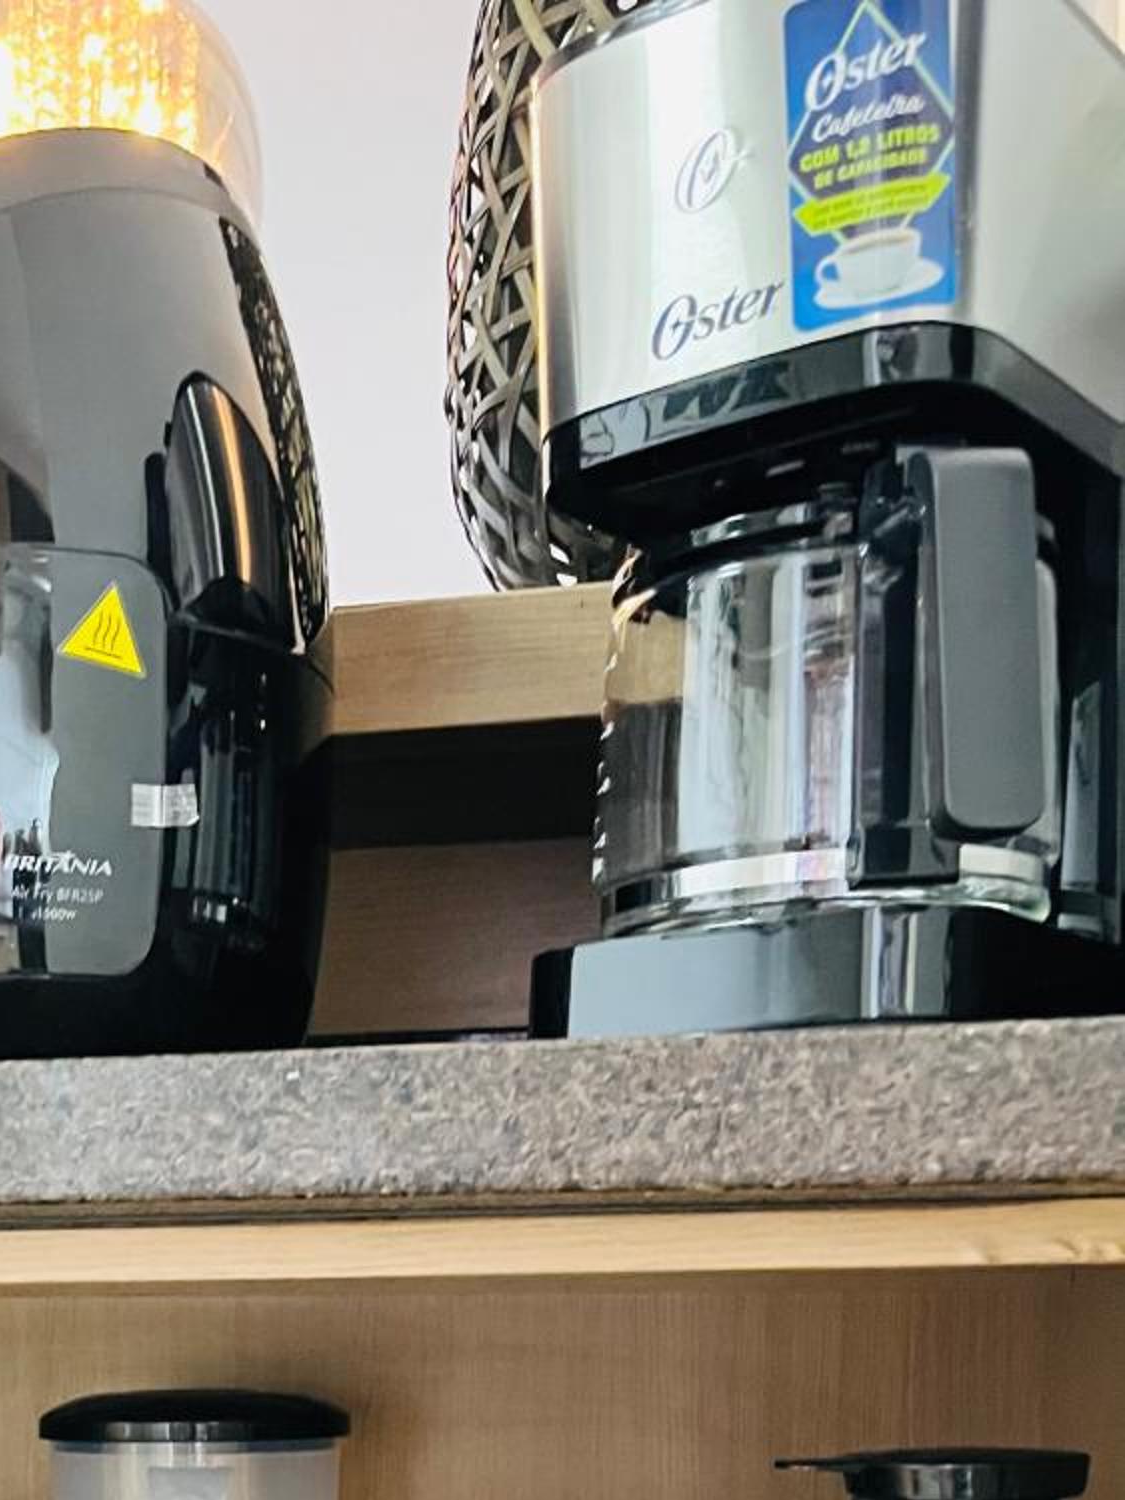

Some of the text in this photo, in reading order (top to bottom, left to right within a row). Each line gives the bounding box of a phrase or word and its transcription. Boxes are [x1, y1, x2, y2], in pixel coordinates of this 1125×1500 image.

[805, 31, 928, 111] Oster
[811, 93, 925, 143] Cafeteira
[799, 143, 840, 173] COM
[876, 123, 941, 152] LITROS
[813, 147, 928, 190] DE CAPACIDADE
[651, 279, 786, 362] Oster
